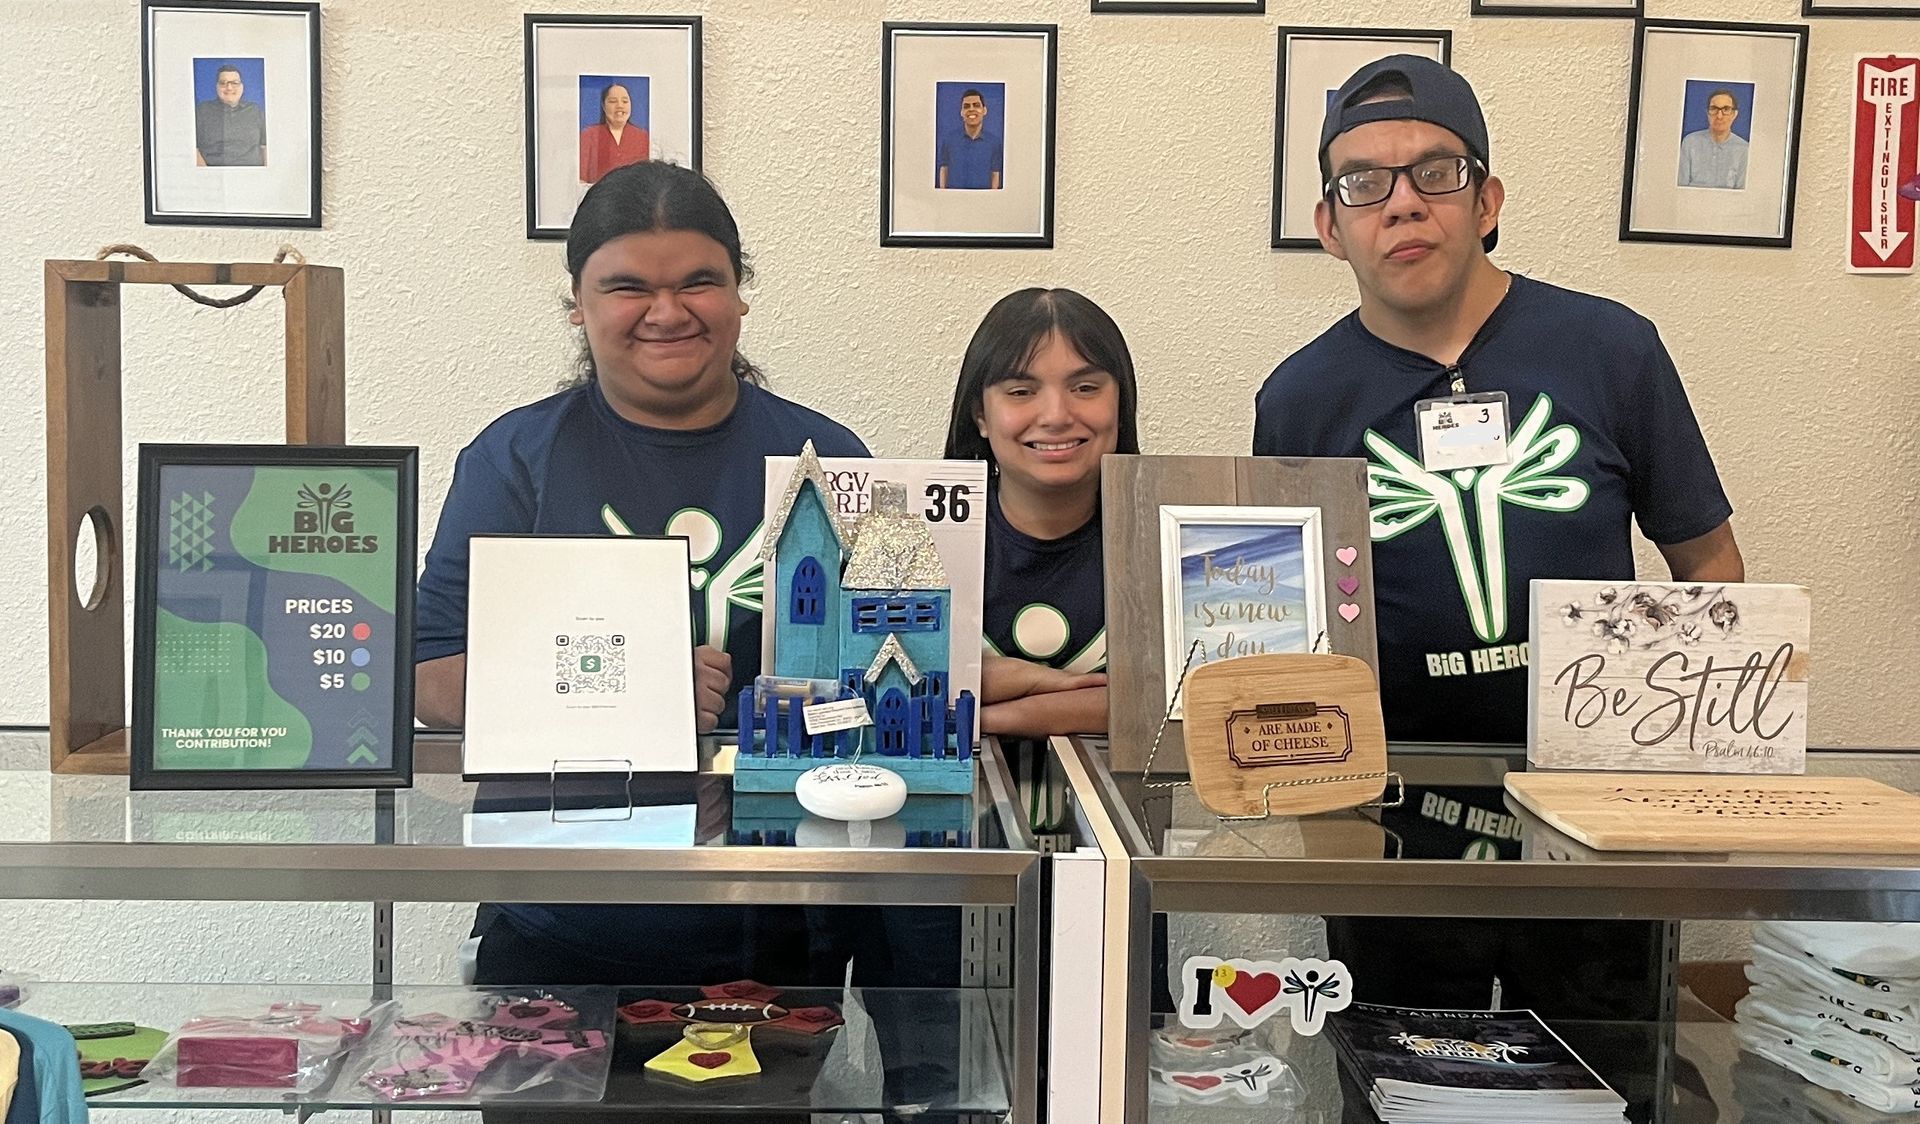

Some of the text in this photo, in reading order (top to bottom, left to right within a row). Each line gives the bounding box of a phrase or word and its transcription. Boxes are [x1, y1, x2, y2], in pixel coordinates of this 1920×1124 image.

[1871, 78, 1908, 96] FIRE
[1880, 103, 1893, 249] EXTINGUISHER
[1478, 408, 1490, 424] 3
[824, 471, 869, 492] RGV
[925, 484, 970, 522] 36
[269, 535, 378, 554] HEROES
[1201, 553, 1276, 596] Today
[285, 599, 353, 614] PRICES
[1194, 601, 1292, 627] is a new
[310, 623, 346, 640] $20
[313, 649, 346, 666] $10
[320, 673, 345, 690] $5
[1554, 642, 1795, 751] Be Still
[162, 727, 287, 738] THANK YOU FOR YOU
[1259, 721, 1322, 736] ARE MADE
[176, 738, 272, 749] CONTRIBUTION!
[1252, 736, 1329, 752] OF CHEESE
[1702, 739, 1744, 758] Psalm
[1193, 968, 1215, 1015] I
[1396, 1010, 1494, 1019] CALENDAR
